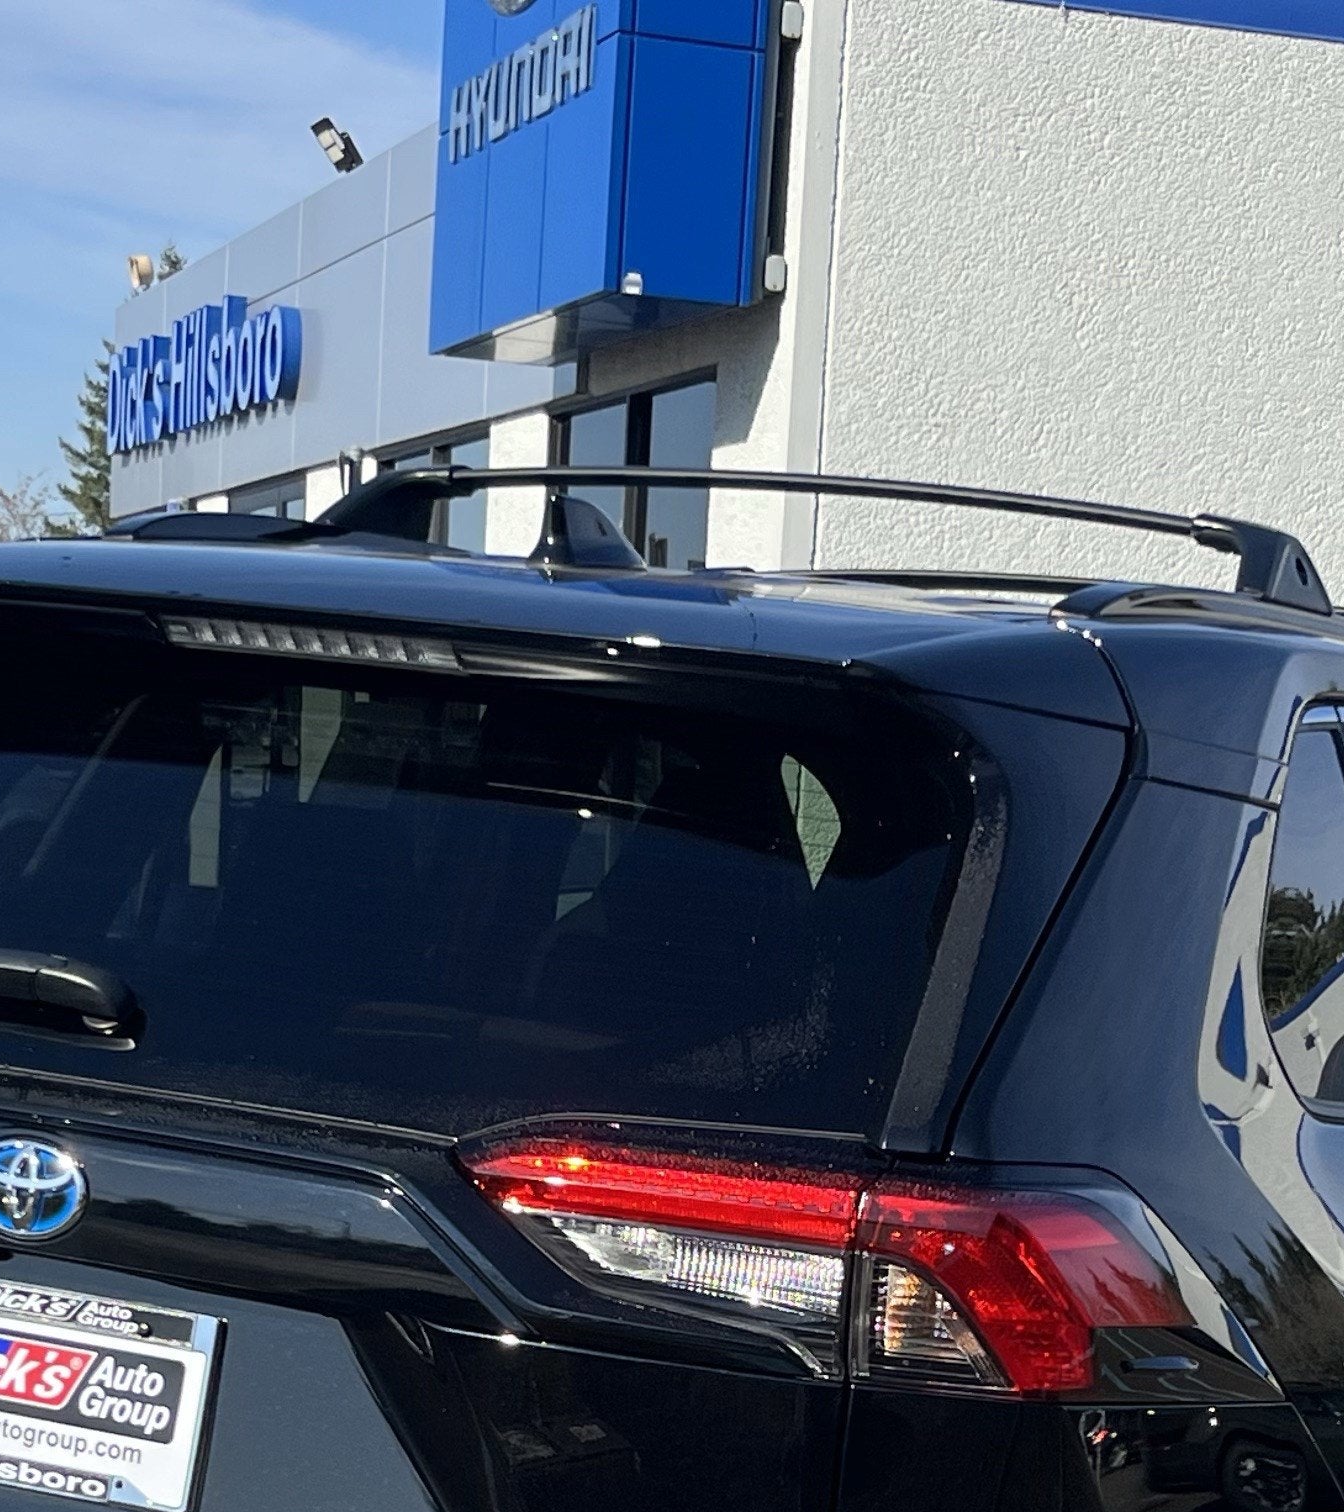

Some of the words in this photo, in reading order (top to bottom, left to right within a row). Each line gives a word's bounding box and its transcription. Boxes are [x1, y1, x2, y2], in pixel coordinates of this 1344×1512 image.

[449, 3, 597, 165] HYUNDAI
[107, 334, 164, 456] Dick's
[169, 294, 286, 434] Hillsboro
[77, 1312, 139, 1335] Group
[83, 1301, 133, 1320] Auto
[88, 1355, 165, 1398] Auto
[78, 1384, 171, 1436] Group
